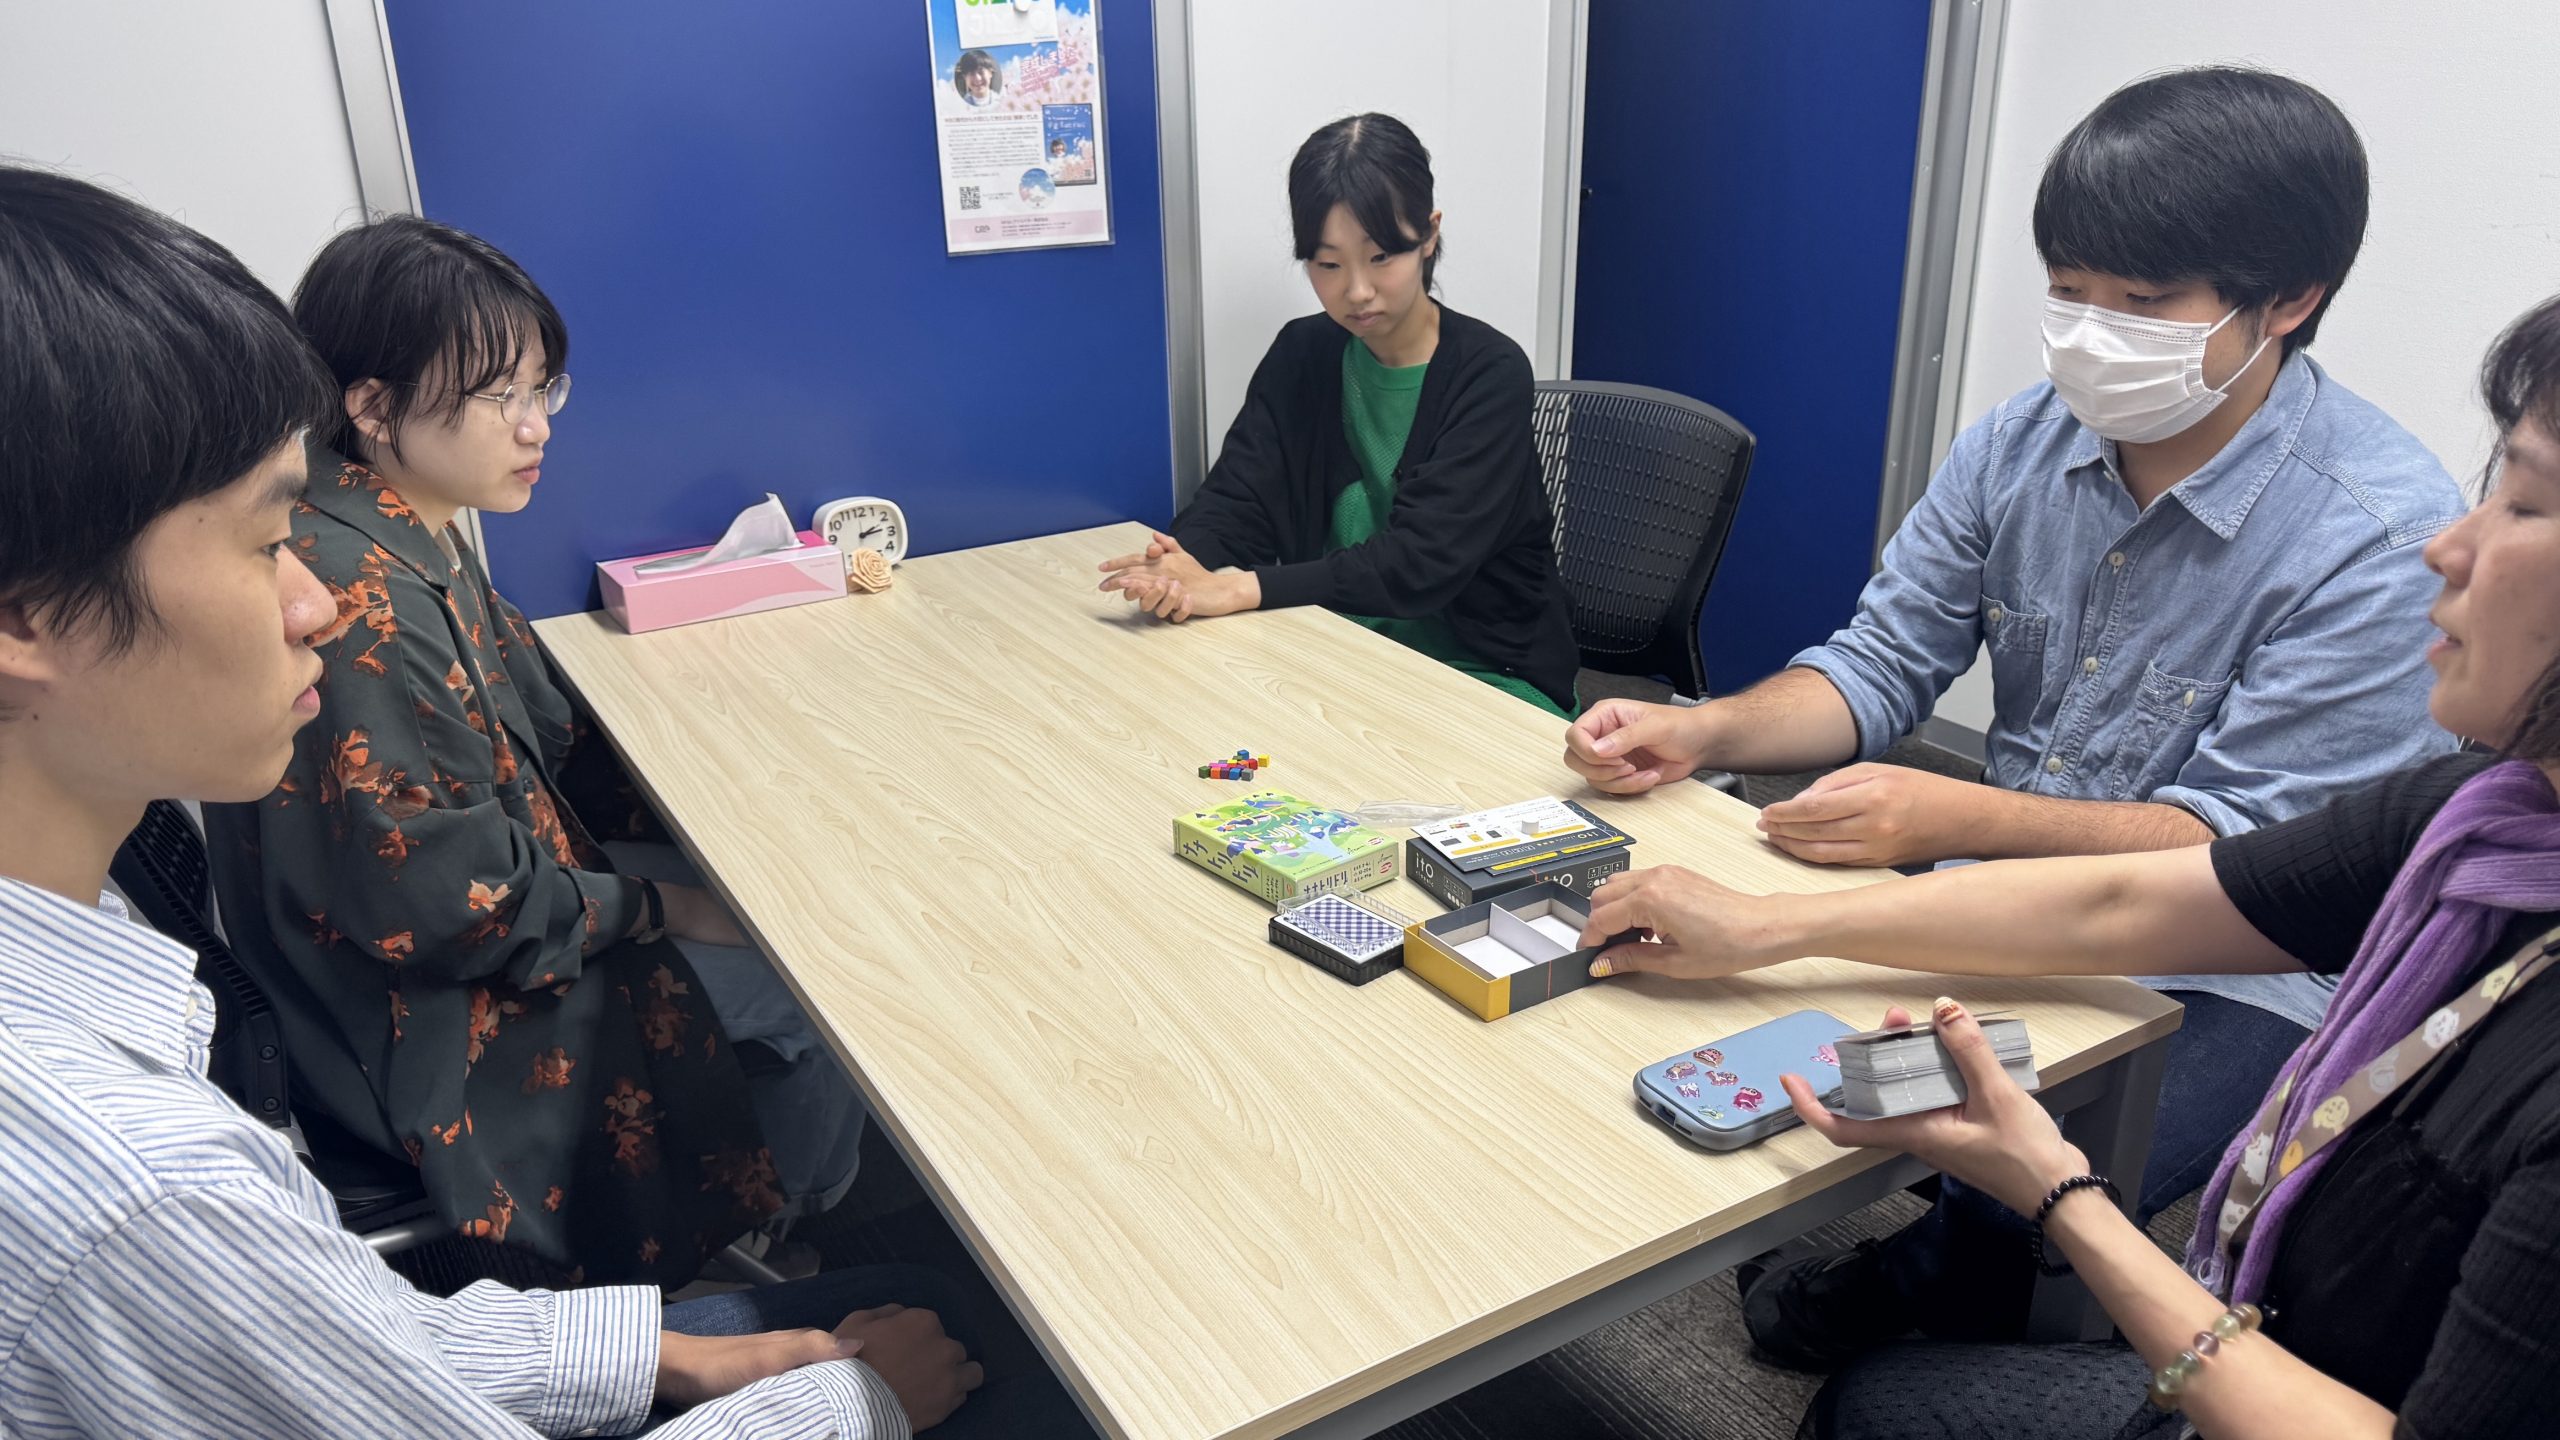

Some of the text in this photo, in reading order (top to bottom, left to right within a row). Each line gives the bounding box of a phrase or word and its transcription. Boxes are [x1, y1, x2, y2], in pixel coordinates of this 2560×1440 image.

[840, 511, 851, 521] 11
[852, 507, 866, 518] 12
[870, 507, 875, 516] 1
[880, 511, 888, 521] 2
[829, 520, 842, 531] 10
[887, 526, 896, 536] 3
[828, 535, 838, 545] 9
[885, 541, 895, 551] 4
